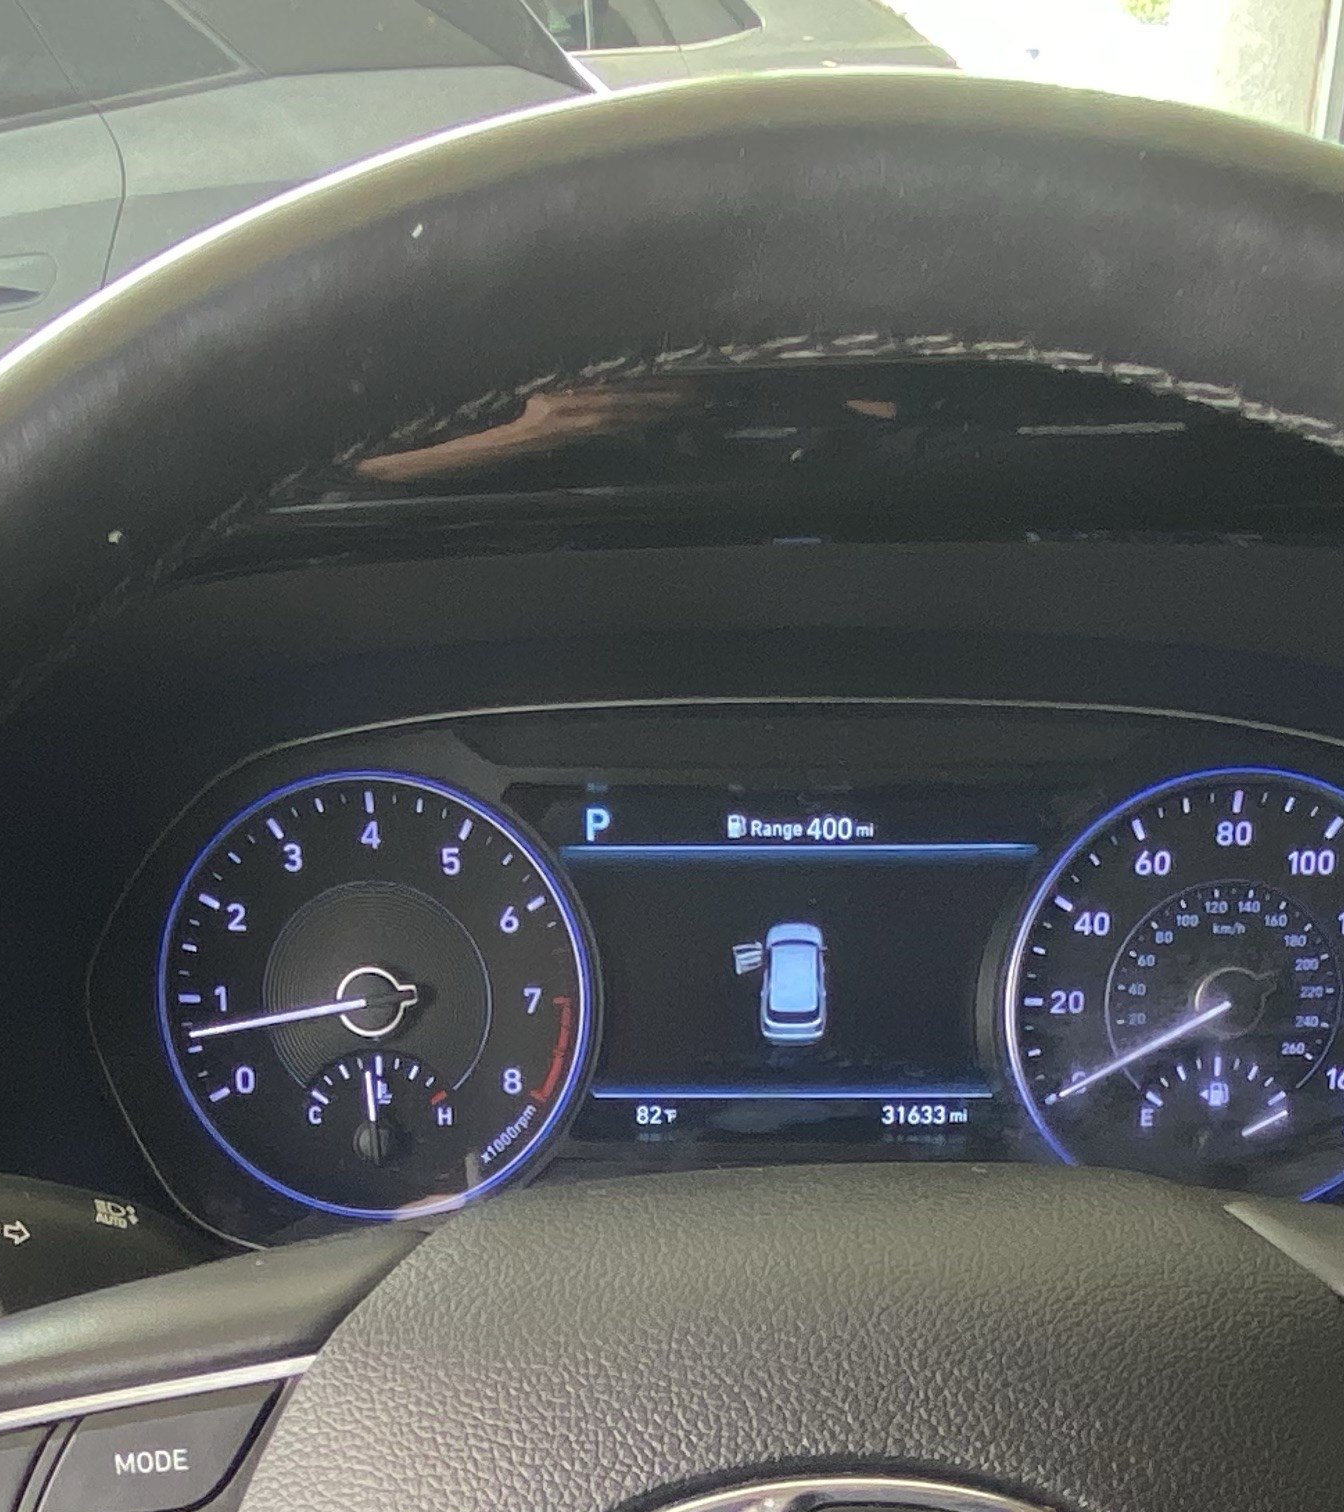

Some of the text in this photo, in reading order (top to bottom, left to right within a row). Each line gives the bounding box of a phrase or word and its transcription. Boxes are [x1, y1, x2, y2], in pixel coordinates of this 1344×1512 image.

[360, 822, 381, 849] 4
[585, 808, 610, 841] P
[751, 817, 874, 841] Range 400 mi
[1216, 821, 1253, 846] 80
[283, 844, 303, 872] 3
[441, 848, 460, 875] 5
[1135, 851, 1171, 876] 60
[1288, 850, 1336, 875] 100
[227, 903, 247, 931] 2
[500, 906, 519, 933] 6
[1206, 902, 1229, 914] 120
[1238, 901, 1261, 914] 140
[1074, 912, 1110, 936] 40
[1176, 914, 1199, 927] 100
[1264, 914, 1288, 927] 160
[1284, 934, 1307, 947] 180
[1137, 955, 1155, 967] 60
[1295, 958, 1319, 971] 200
[214, 987, 228, 1011] 1
[523, 987, 542, 1014] 7
[1128, 983, 1146, 995] 40
[1050, 990, 1085, 1015] 20
[1295, 1015, 1319, 1028] 240
[1282, 1042, 1306, 1055] 260
[235, 1066, 255, 1093] 0
[503, 1068, 522, 1094] 8
[308, 1106, 323, 1125] C
[438, 1107, 453, 1126] H
[882, 1105, 968, 1125] 31633 mi
[1140, 1108, 1153, 1127] E
[481, 1104, 537, 1164] x1000rpm
[114, 1449, 189, 1475] MODE
